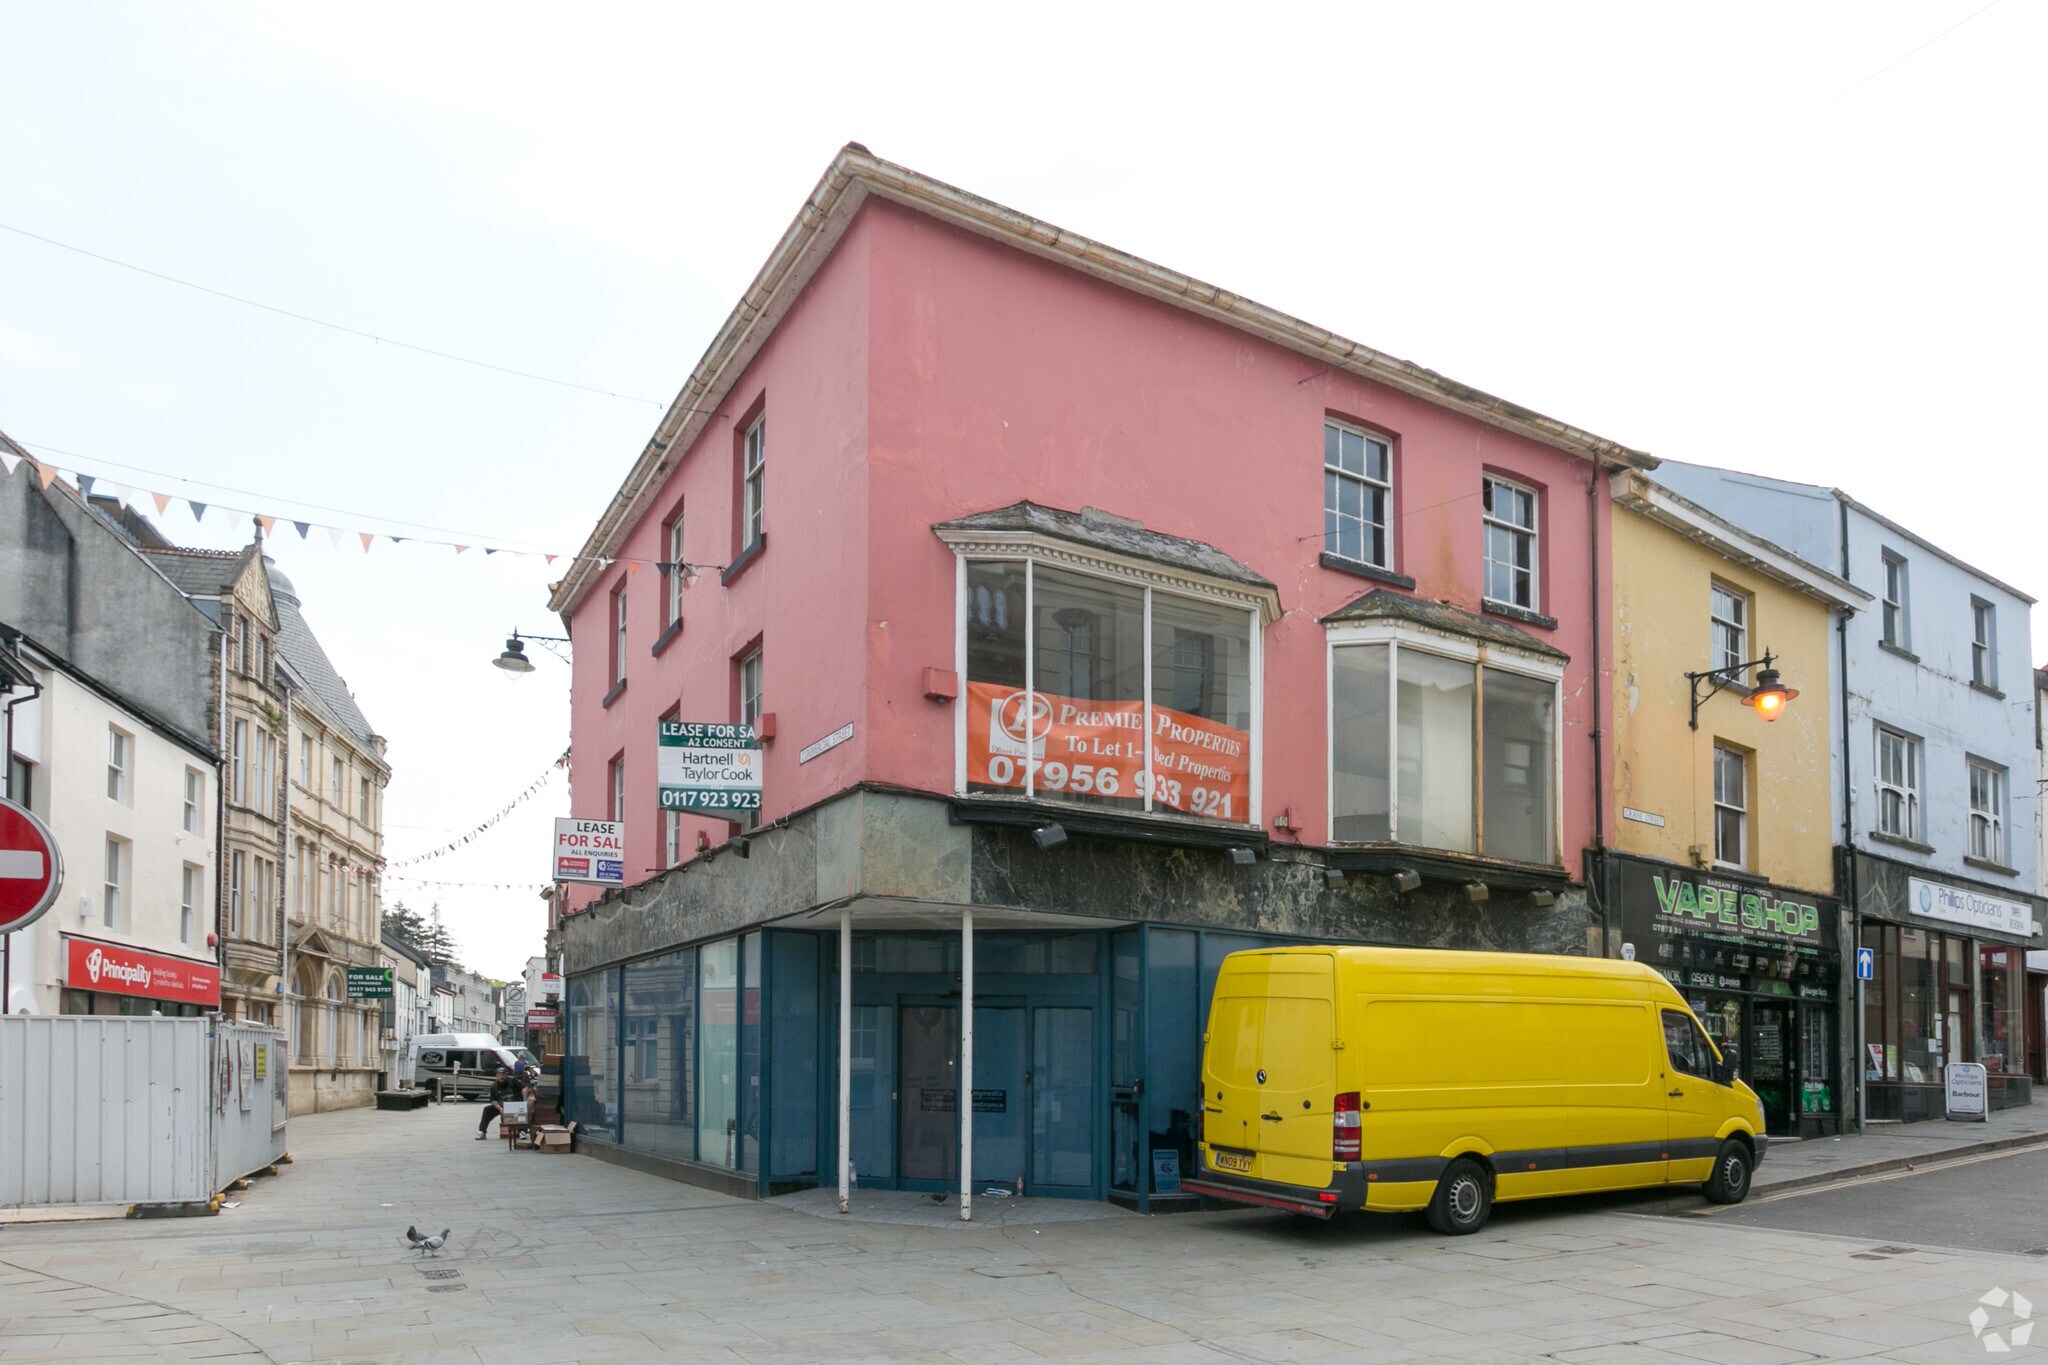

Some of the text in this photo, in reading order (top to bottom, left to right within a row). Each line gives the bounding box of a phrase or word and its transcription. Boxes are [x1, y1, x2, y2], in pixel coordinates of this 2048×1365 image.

[662, 723, 756, 738] LEASE FOR SA
[832, 725, 851, 745] STREET
[1057, 704, 1241, 757] PREMIE PROPERTIES
[688, 738, 747, 748] A2 CONSENT
[682, 752, 734, 765] Hartnell
[1065, 735, 1088, 753] To
[1093, 737, 1121, 757] Let
[1126, 742, 1146, 758] 1-
[1177, 754, 1232, 783] Properties
[682, 767, 753, 782] Taylor Cook
[988, 756, 1232, 818] 07956 933 921
[662, 790, 763, 808] 0117 923 923
[1625, 809, 1663, 825] CRANE STREET
[577, 822, 615, 834] LEASE
[559, 834, 622, 849] FOR SAL
[584, 850, 618, 858] ENQUIRIES
[1707, 879, 1773, 898] BARGAIN BOX PONTYPOOL
[1653, 875, 1819, 936] VAPE SHOP
[1966, 894, 2002, 918] Opticians
[1655, 914, 1684, 924] ELECTRONIC
[1684, 918, 1712, 928] CIGARETTES
[1792, 936, 1819, 945] ACCESSORIES
[102, 957, 151, 989] Principality
[1691, 972, 1715, 984] aspire
[425, 1052, 440, 1063] Ford
[1951, 1078, 1982, 1086] Opticians
[1952, 1090, 1980, 1098] Barbour
[1238, 1158, 1253, 1171] TVY
